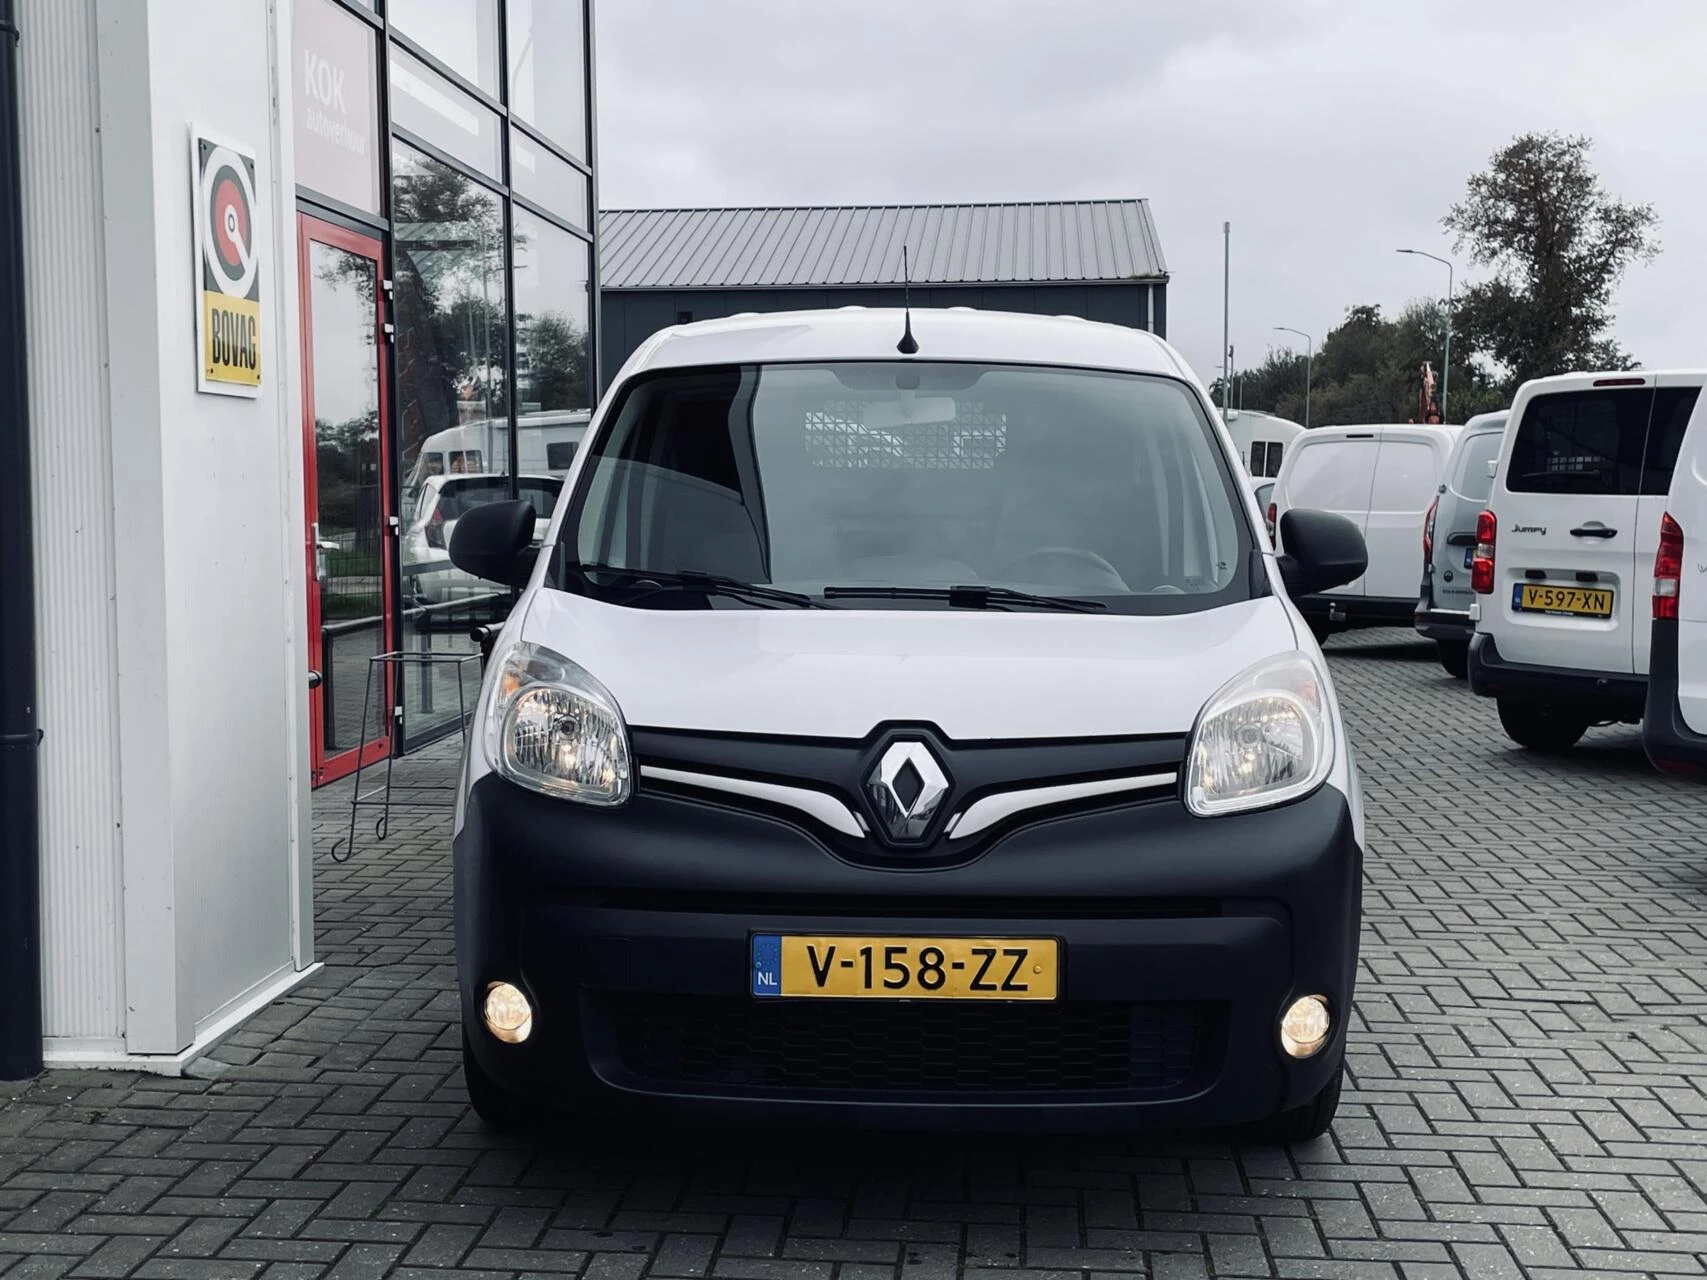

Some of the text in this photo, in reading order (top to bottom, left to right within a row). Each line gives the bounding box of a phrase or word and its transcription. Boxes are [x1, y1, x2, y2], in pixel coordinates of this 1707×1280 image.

[304, 49, 346, 115] KOK
[212, 308, 256, 370] BOVAG
[1528, 587, 1605, 611] V-597-XN
[757, 971, 778, 986] NL
[806, 945, 1029, 992] V-158-ZZ
